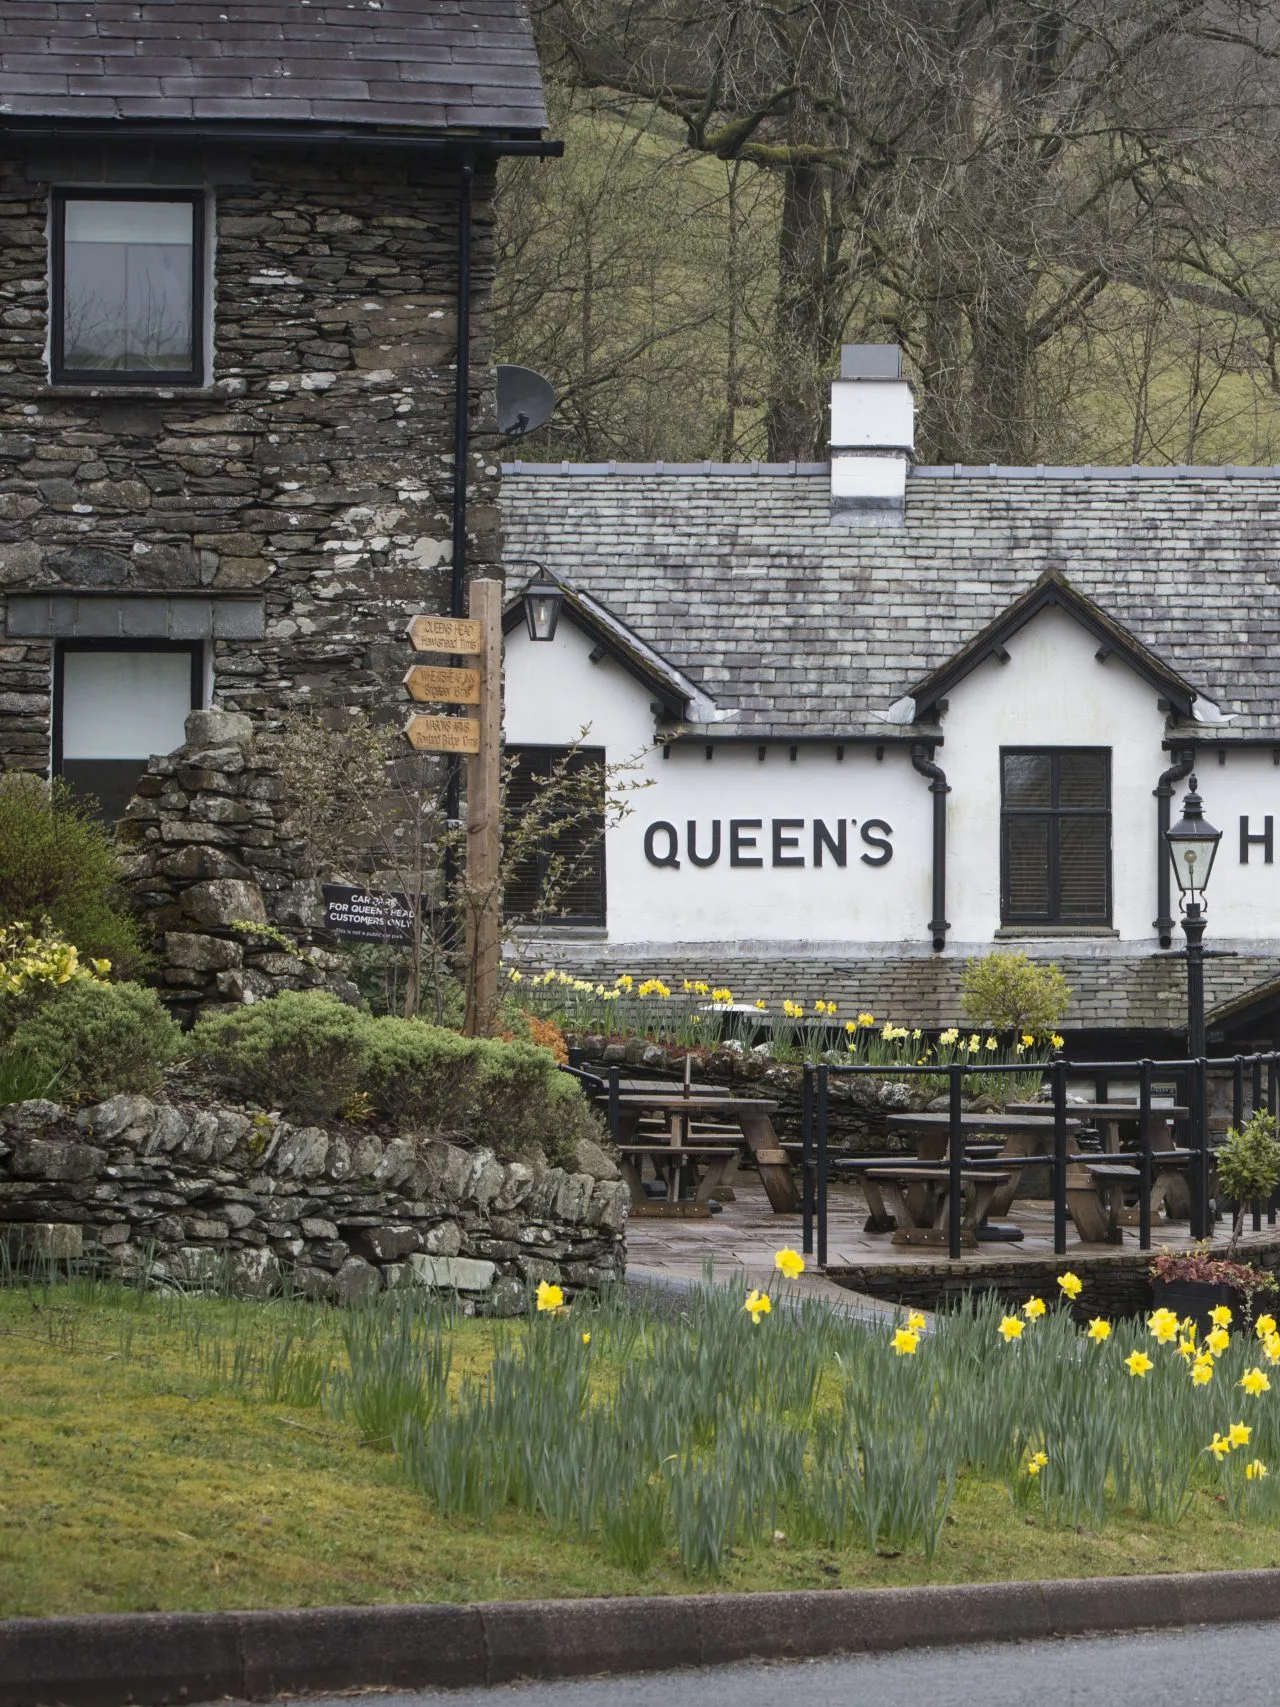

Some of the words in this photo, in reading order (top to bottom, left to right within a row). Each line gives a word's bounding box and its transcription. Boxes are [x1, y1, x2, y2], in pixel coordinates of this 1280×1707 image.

[425, 622, 452, 634] QUEENS
[454, 623, 474, 636] HEAD
[421, 636, 457, 649] Hawkshead
[453, 721, 470, 733] ARMS
[644, 818, 893, 869] QUEEN'S
[351, 895, 370, 904] CAR
[329, 902, 349, 912] FOR
[390, 908, 415, 919] HEAD
[330, 913, 384, 926] CUSTOMERS
[387, 918, 412, 928] ONLY
